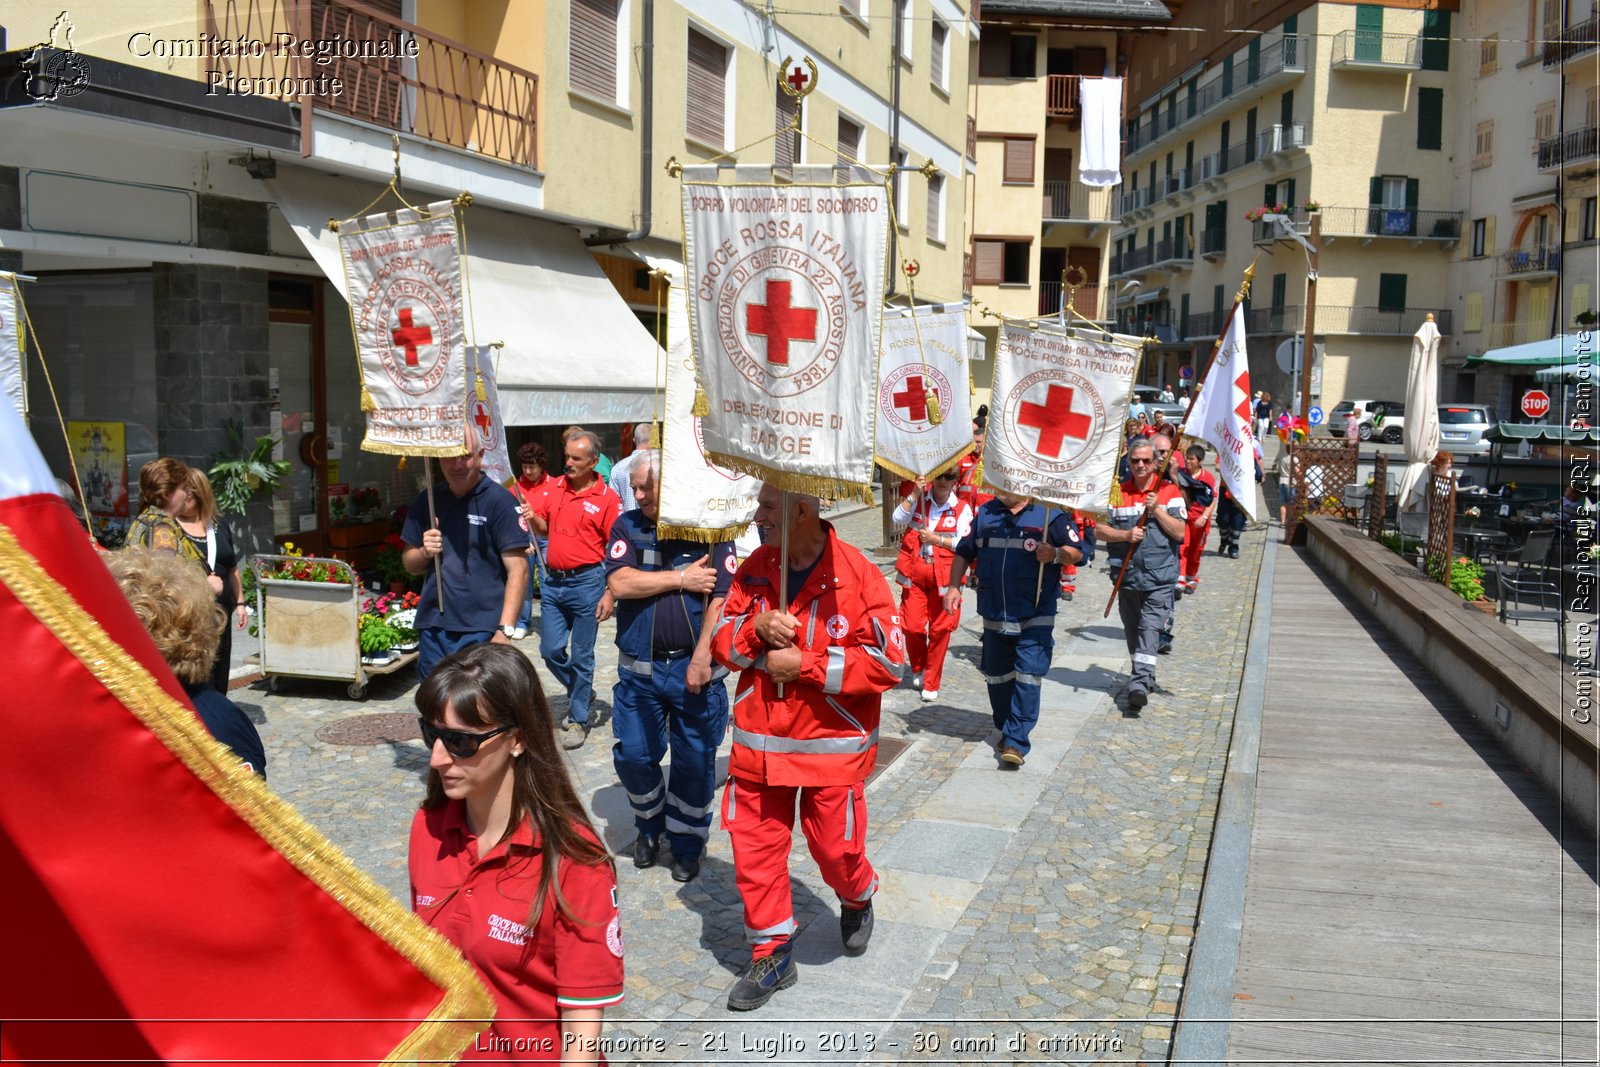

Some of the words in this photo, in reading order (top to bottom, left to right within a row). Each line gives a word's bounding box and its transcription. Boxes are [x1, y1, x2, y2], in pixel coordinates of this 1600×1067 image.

[692, 197, 725, 213] CORPO
[730, 197, 787, 213] VOLONTARI
[791, 197, 813, 213] DEL
[816, 197, 878, 214] SOCCORSO
[698, 238, 739, 302] CROCE
[739, 220, 804, 247] ROSSA
[810, 229, 868, 314] ITALIANA
[732, 263, 750, 283] DI
[750, 249, 810, 274] GINEVRA
[812, 269, 834, 290] 22
[359, 279, 382, 332] CROCE
[377, 257, 415, 284] ROSSA
[719, 282, 767, 385] CONVENZIONE
[825, 294, 845, 362] AGOSTO
[1000, 343, 1039, 360] CROCE
[1041, 353, 1081, 369] ROSSA
[1085, 360, 1135, 376] ITALIANA
[1033, 338, 1073, 355] VOLONTARI
[1075, 346, 1090, 357] DEL
[1093, 349, 1132, 363] SOCCORSO
[793, 363, 827, 390] 1864
[1010, 369, 1069, 401] CONVENZIONE
[1071, 376, 1081, 386] DI
[1082, 382, 1105, 420] GINEVRA
[1523, 398, 1548, 410] STOP
[372, 406, 414, 422] GRUPPO
[419, 406, 433, 421] DI
[722, 399, 824, 428] DELEGAZIONE
[830, 414, 843, 431] DI
[373, 423, 424, 441] COMITATO
[750, 425, 813, 455] BARGE
[990, 460, 1039, 481] COMITATO
[1040, 474, 1084, 491] LOCALE
[1086, 482, 1096, 493] DI
[1002, 479, 1081, 505] RACCONIGI
[487, 913, 512, 930] CROCE
[488, 926, 528, 946] ITALIANA
